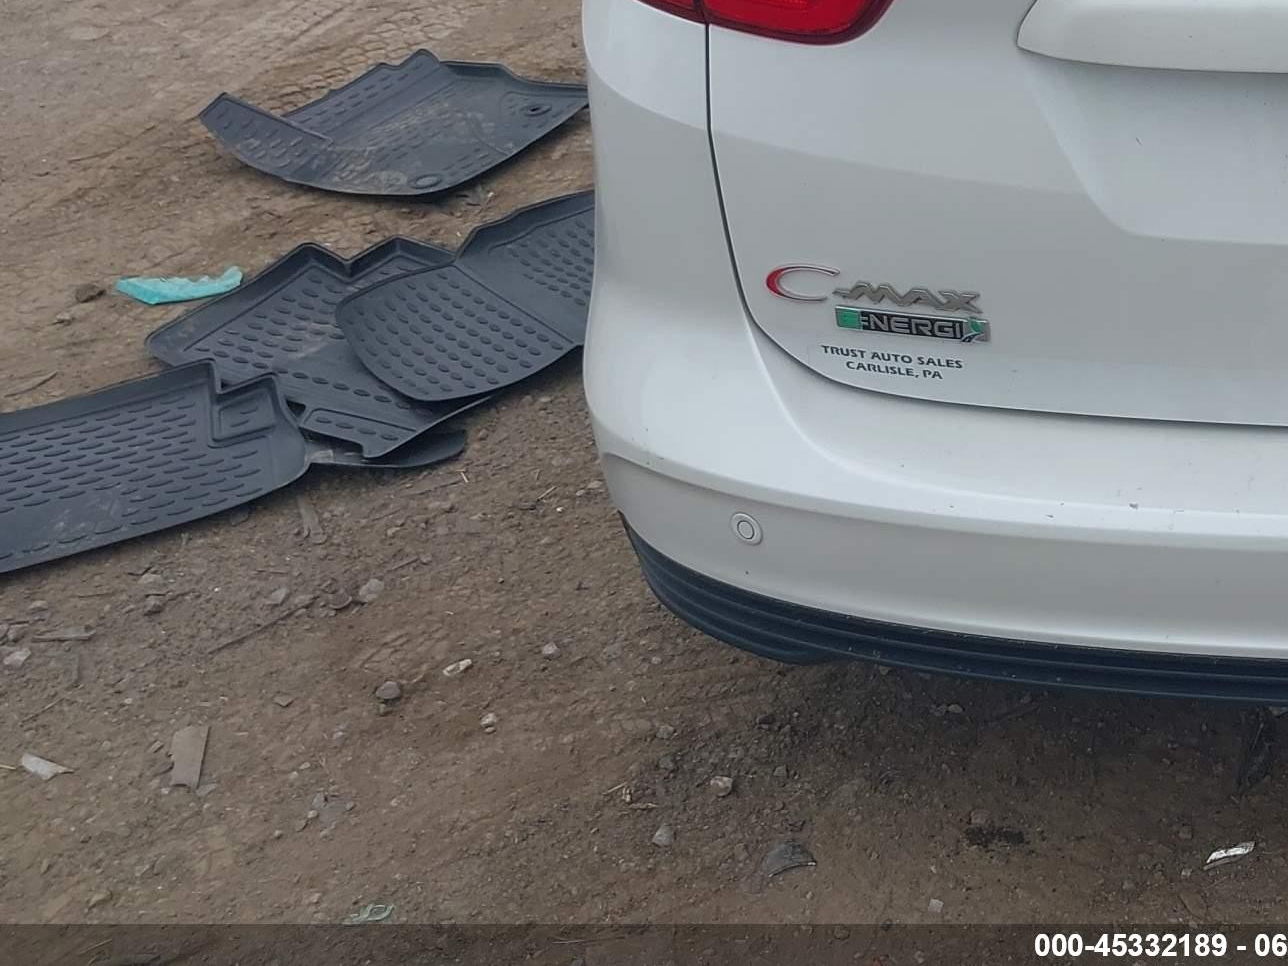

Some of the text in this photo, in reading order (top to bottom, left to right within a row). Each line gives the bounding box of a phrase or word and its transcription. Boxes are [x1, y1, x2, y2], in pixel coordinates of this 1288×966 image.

[821, 344, 963, 369] TRUST AUTO SALES
[846, 361, 943, 380] CARLISLE, PA
